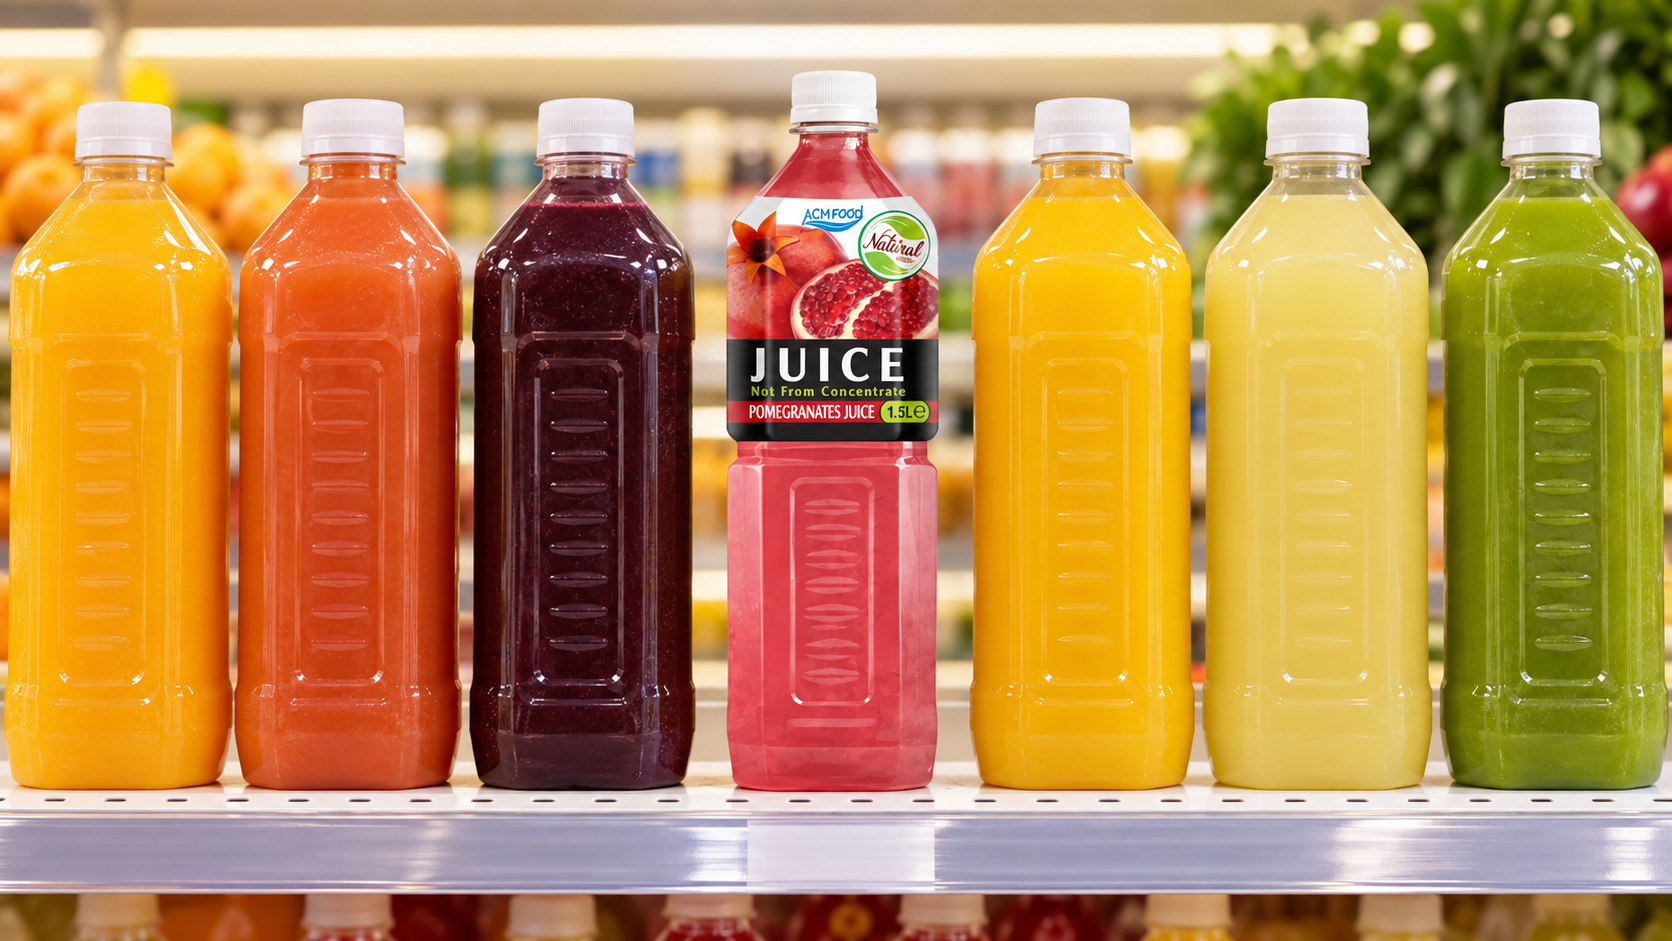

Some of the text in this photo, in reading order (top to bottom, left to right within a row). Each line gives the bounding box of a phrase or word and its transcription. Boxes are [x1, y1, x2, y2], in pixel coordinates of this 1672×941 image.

[863, 229, 925, 257] Natural
[750, 347, 905, 382] JUICE
[751, 386, 906, 397] Not From Concentrate
[749, 404, 875, 419] POMEGRANATES JUICE
